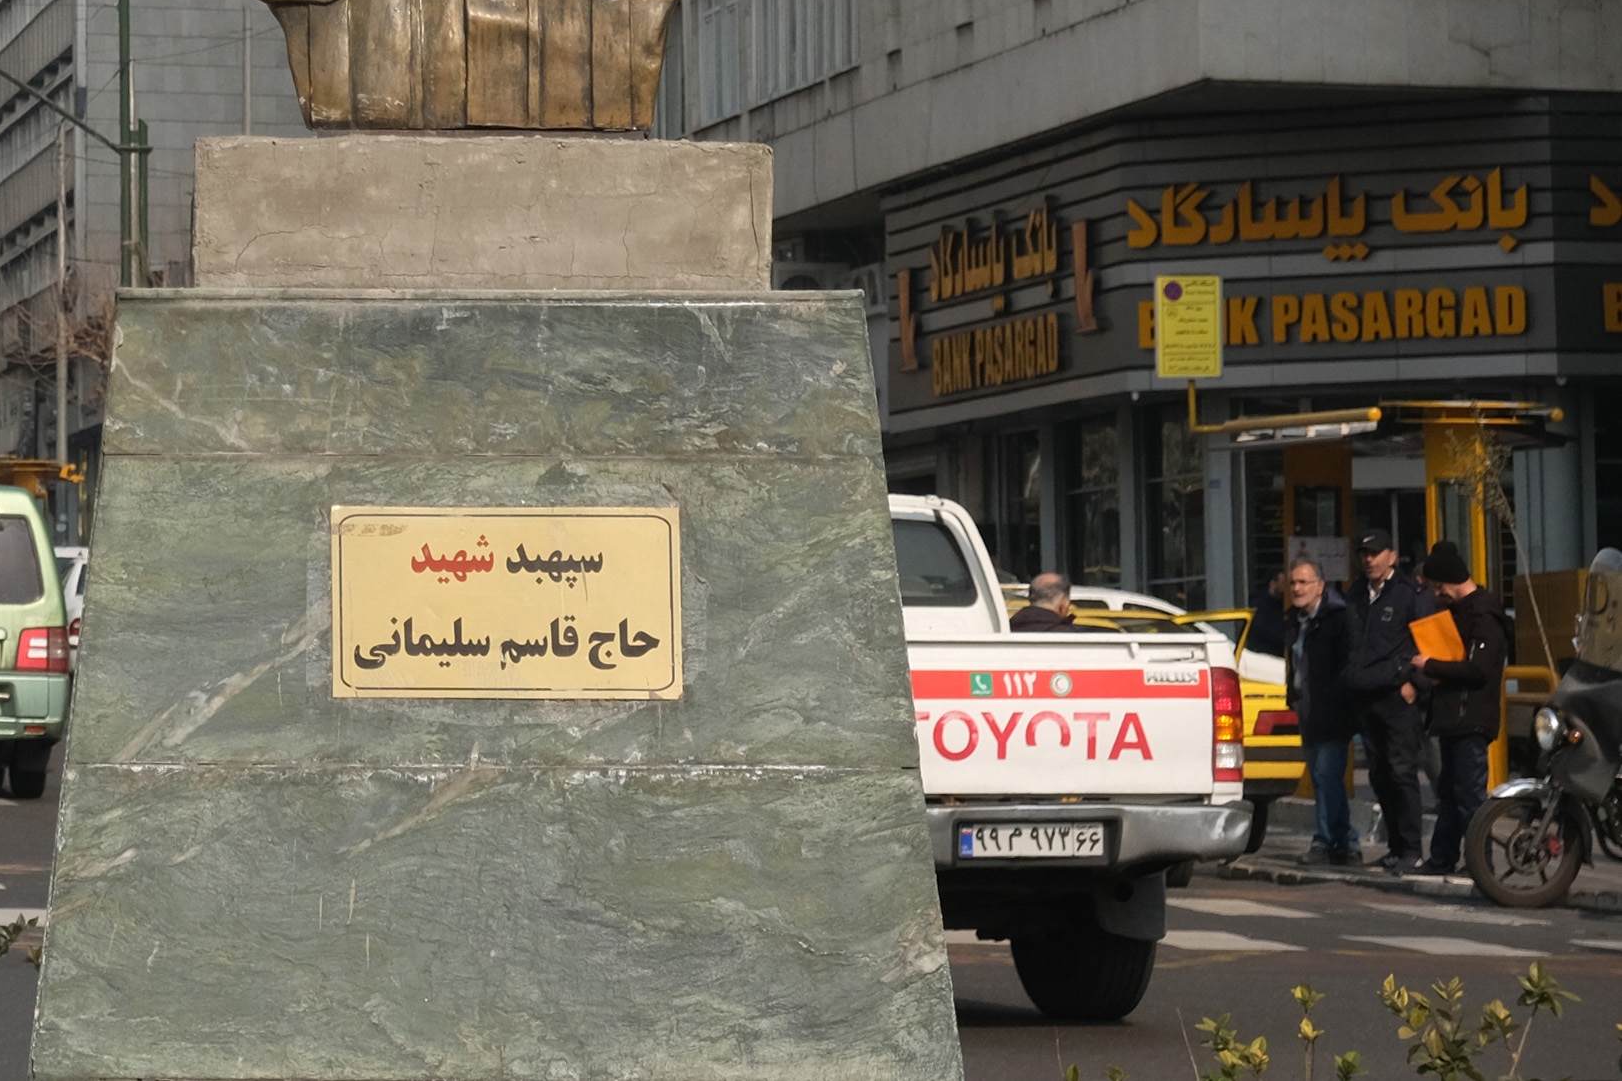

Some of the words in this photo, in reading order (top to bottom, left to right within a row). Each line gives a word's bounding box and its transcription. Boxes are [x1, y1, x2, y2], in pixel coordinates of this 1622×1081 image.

[1127, 175, 1370, 262] پاسارگاد
[1392, 166, 1529, 253] بانک
[930, 220, 1005, 312] پاسارگاد
[1012, 203, 1057, 298] بانک
[1138, 296, 1259, 350] BK
[1272, 284, 1527, 344] PASARGAD
[932, 330, 972, 396] BANK
[974, 311, 1059, 387] PASARGAD
[410, 534, 495, 584] شهید
[505, 543, 604, 589] سپهبد
[353, 616, 491, 670] سلیمانی
[499, 615, 579, 671] قاسم
[587, 617, 661, 669] حاج
[1003, 672, 1037, 697] ۱۱۲
[915, 709, 1154, 762] OYOTA
[975, 826, 1002, 852] ۹۹
[1029, 826, 1071, 852] ۹۷۳
[1075, 831, 1101, 852] ۶۶
